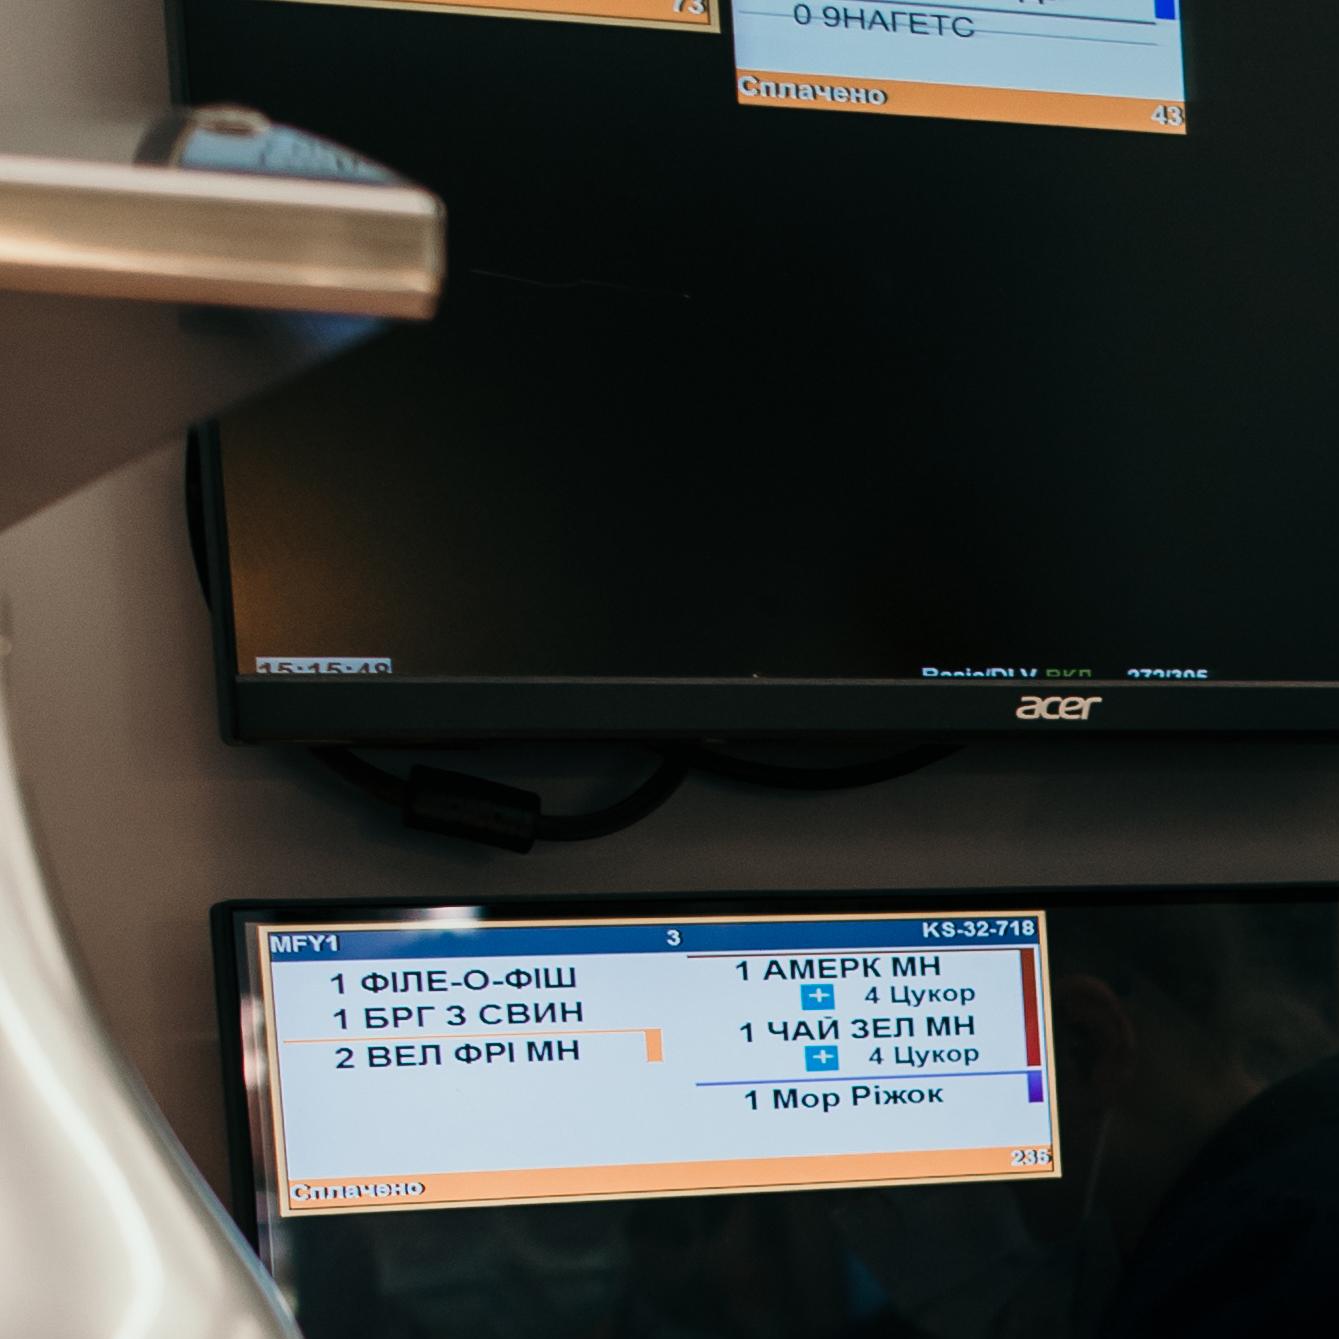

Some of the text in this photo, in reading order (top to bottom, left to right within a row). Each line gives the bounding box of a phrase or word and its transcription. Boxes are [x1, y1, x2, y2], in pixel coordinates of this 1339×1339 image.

[793, 4, 975, 38] 0 9НАГЕТС
[738, 75, 887, 106] Сплачено
[1150, 105, 1185, 127] 43
[1016, 696, 1102, 720] acer
[666, 929, 682, 946] 3
[922, 919, 1036, 939] KS-32-718
[270, 934, 340, 954] MFY1
[330, 966, 577, 994] 1 ФІЛЕ-О-ФІШ
[736, 956, 941, 981] 1 АМЕРК МН
[865, 985, 976, 1008] 4 Цукор
[333, 1008, 348, 1030] 1
[365, 1006, 435, 1029] БРГ
[479, 1001, 584, 1026] СВИН
[740, 1015, 975, 1043] 1 ЧАЙ ЗЕЛ МН
[335, 1040, 580, 1069] 2 ВЕЛ ФРІ МН
[869, 1045, 980, 1069] 4 Цукор
[744, 1085, 944, 1112] 1 Мор Ріжок
[291, 1180, 425, 1201] Сплачено
